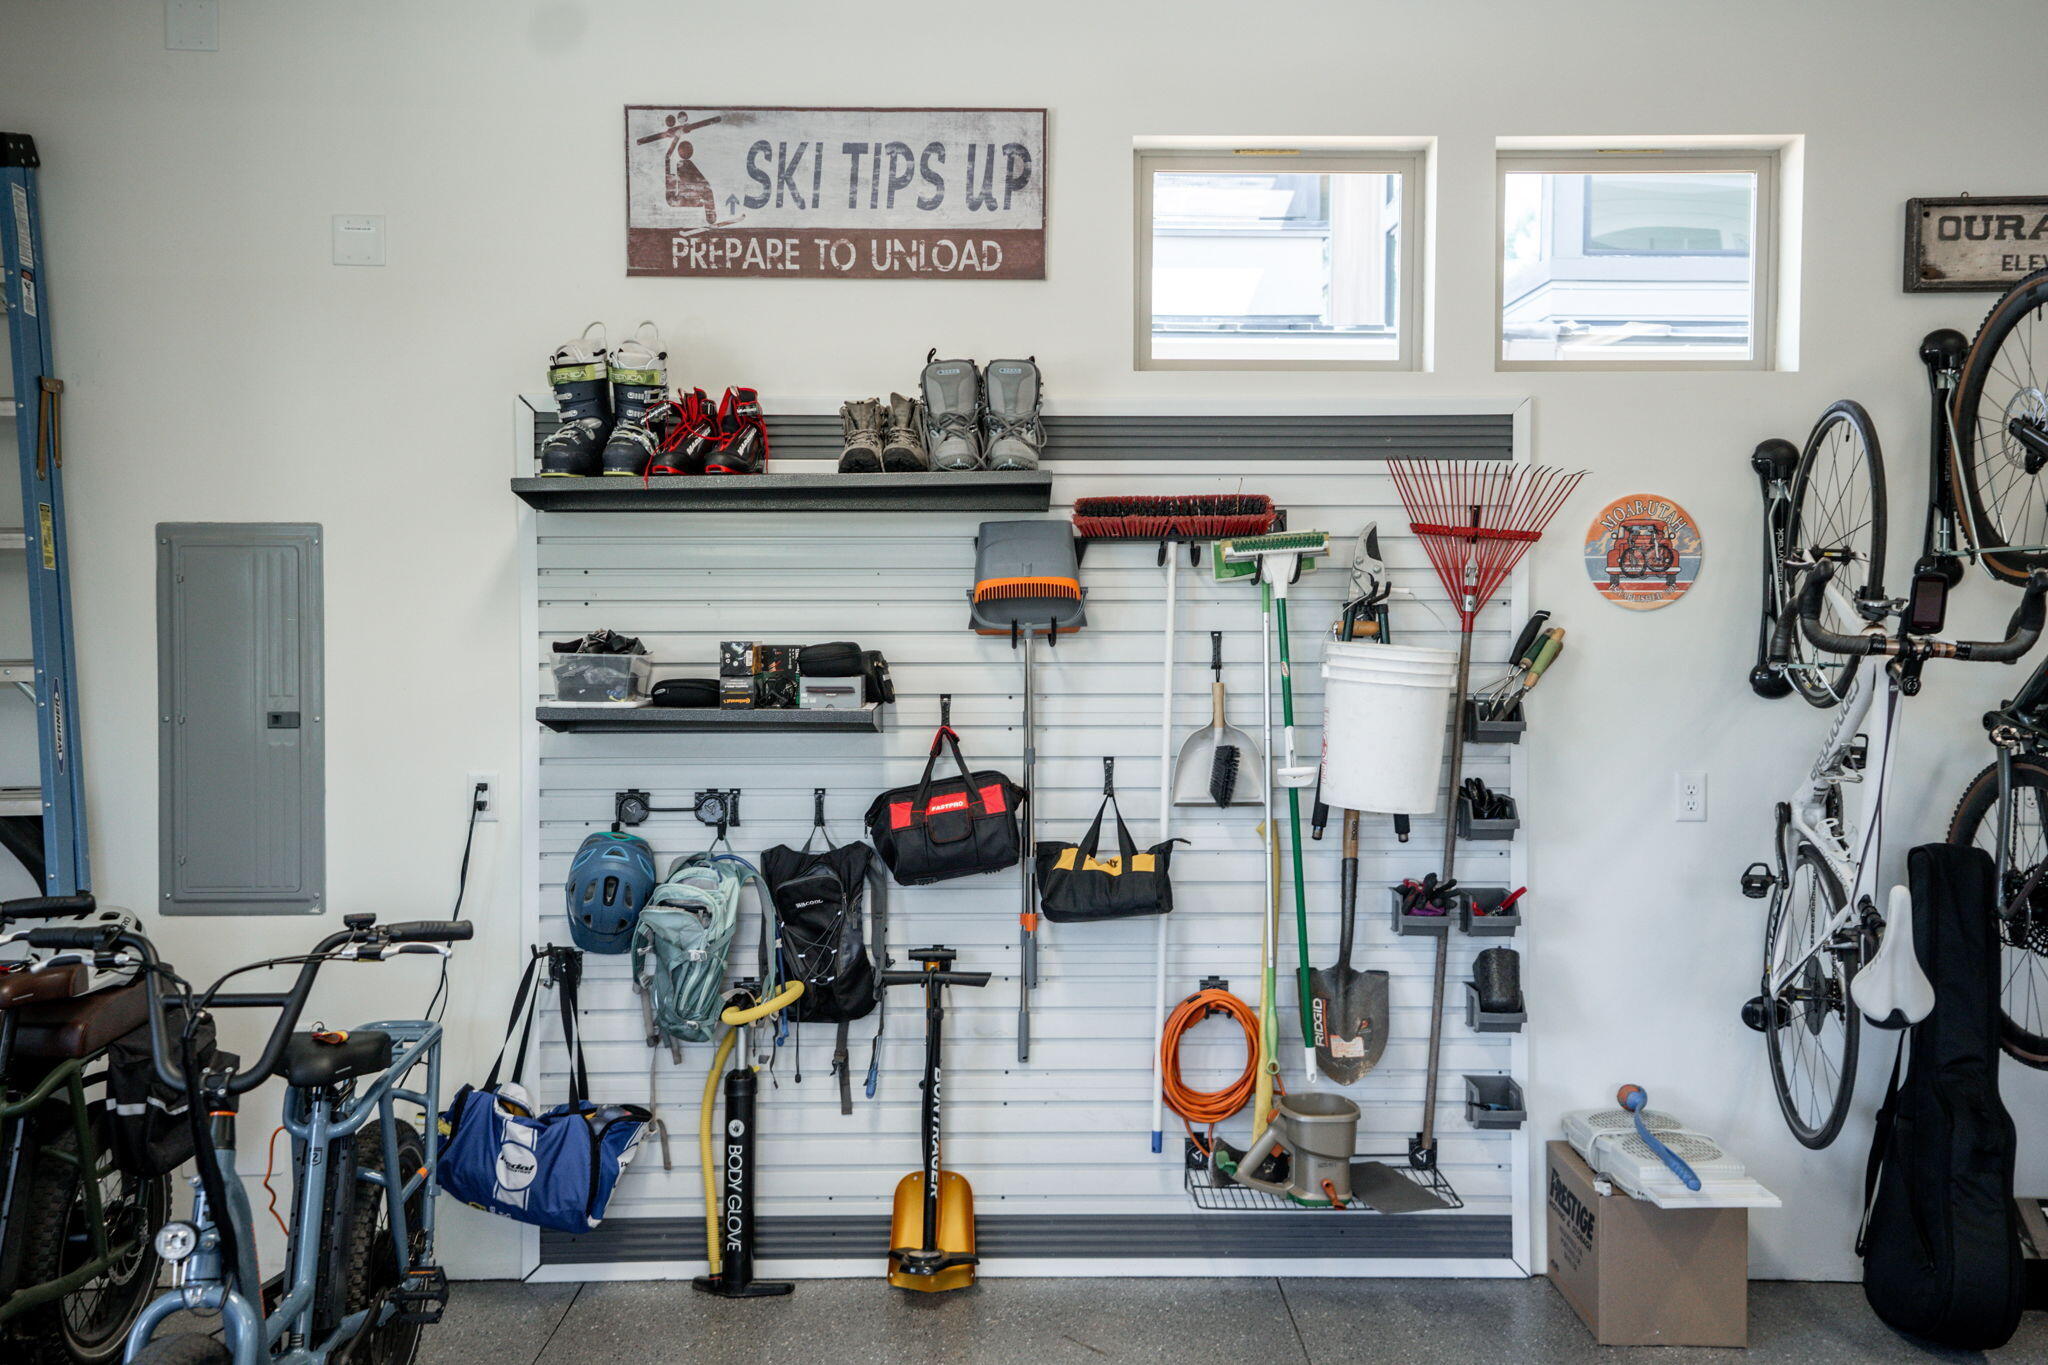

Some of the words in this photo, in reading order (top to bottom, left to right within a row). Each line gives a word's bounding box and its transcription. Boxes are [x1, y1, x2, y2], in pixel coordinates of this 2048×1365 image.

[743, 139, 824, 210] SKI
[841, 141, 946, 211] TIPS
[966, 142, 1033, 212] UP
[1938, 214, 2048, 241] OURA
[672, 237, 800, 271] PREPARE
[814, 237, 857, 271] TO
[871, 237, 1003, 272] UNLOAD
[55, 697, 63, 752] WERNER
[931, 800, 963, 812] FASTPRO
[1313, 998, 1325, 1047] RIDGID
[930, 1067, 941, 1198] BONTRAGER
[728, 1144, 743, 1192] BODY
[727, 1194, 742, 1252] GLOVE
[1550, 1167, 1595, 1241] PRESTIGE
